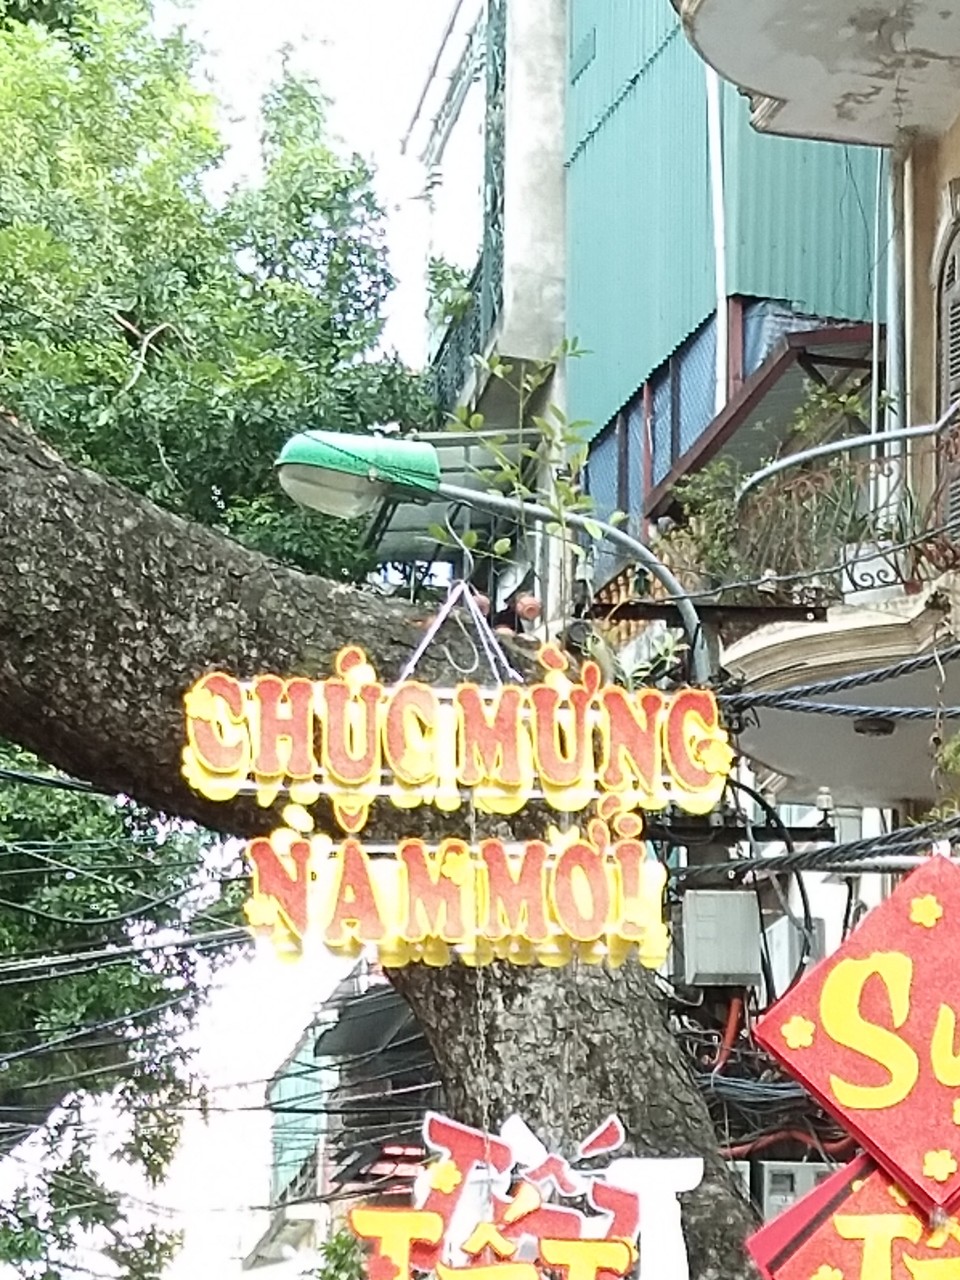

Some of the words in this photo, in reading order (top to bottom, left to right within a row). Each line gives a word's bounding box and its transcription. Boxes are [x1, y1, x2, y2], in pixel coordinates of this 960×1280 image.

[184, 646, 438, 786] CHÚC
[456, 643, 724, 793] MỪNG
[246, 798, 468, 946] NĂM
